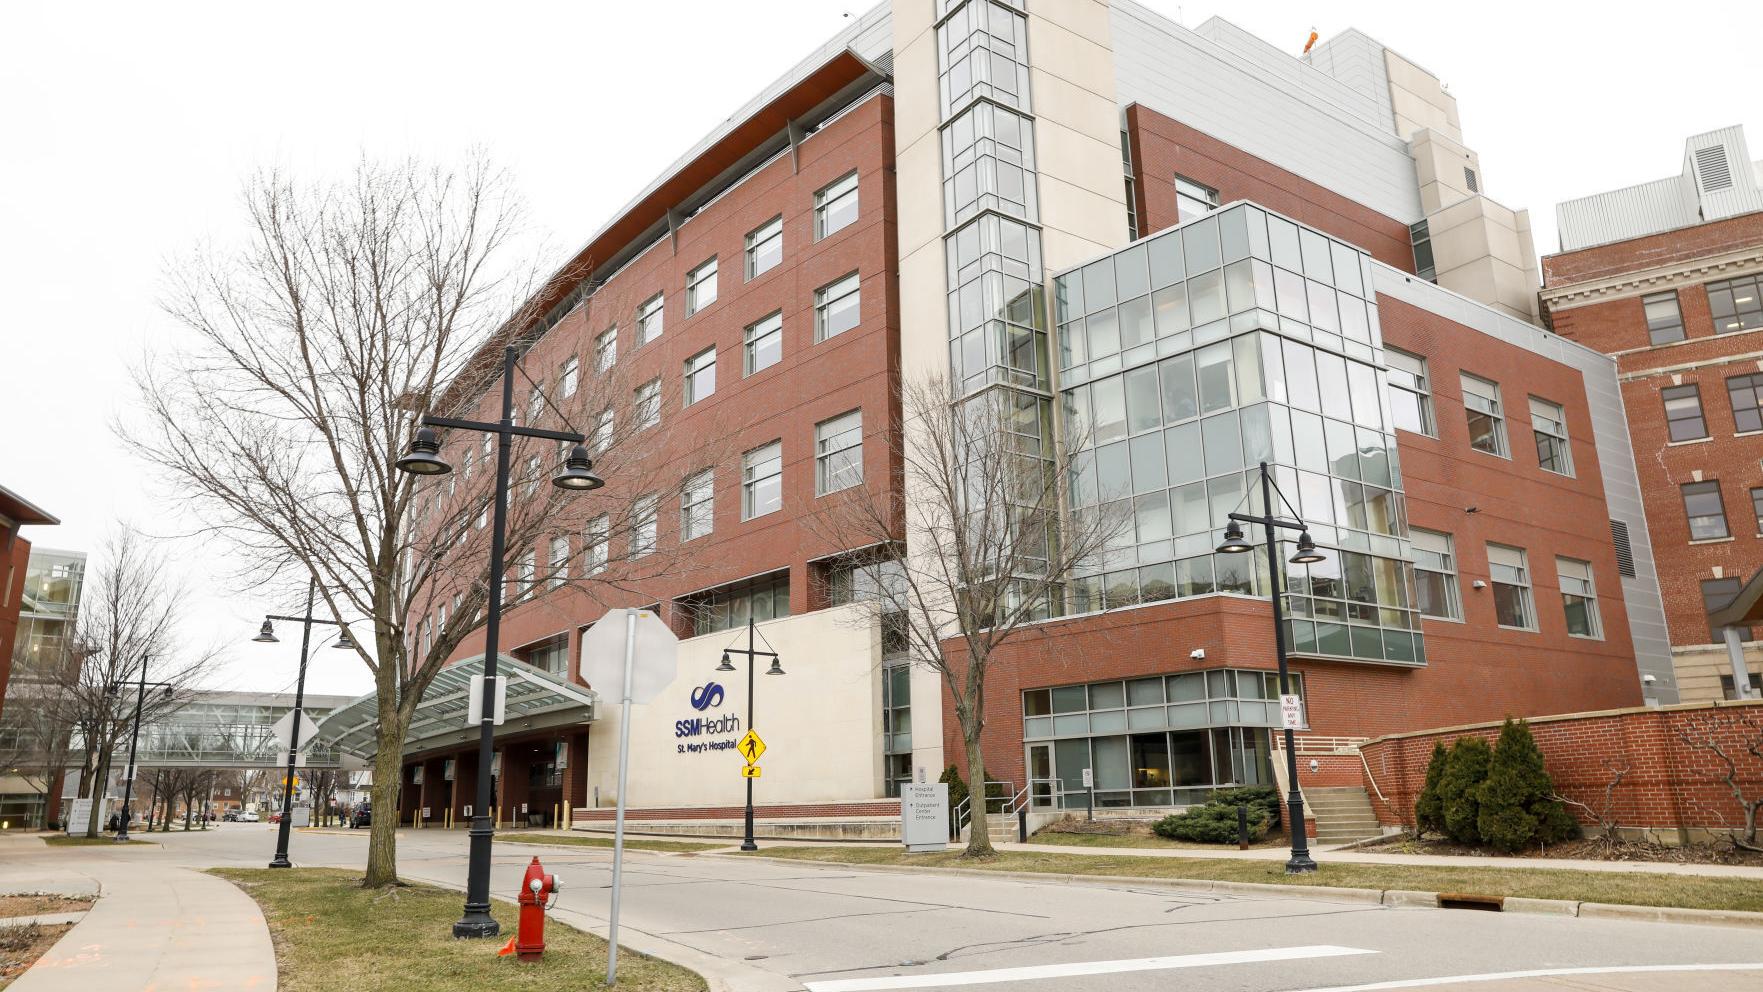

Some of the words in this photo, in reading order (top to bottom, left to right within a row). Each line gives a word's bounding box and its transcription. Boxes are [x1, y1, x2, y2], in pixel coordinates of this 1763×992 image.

[1285, 697, 1294, 705] NO
[677, 743, 686, 754] St.
[687, 742, 708, 754] Mary's
[708, 739, 737, 752] Hospital
